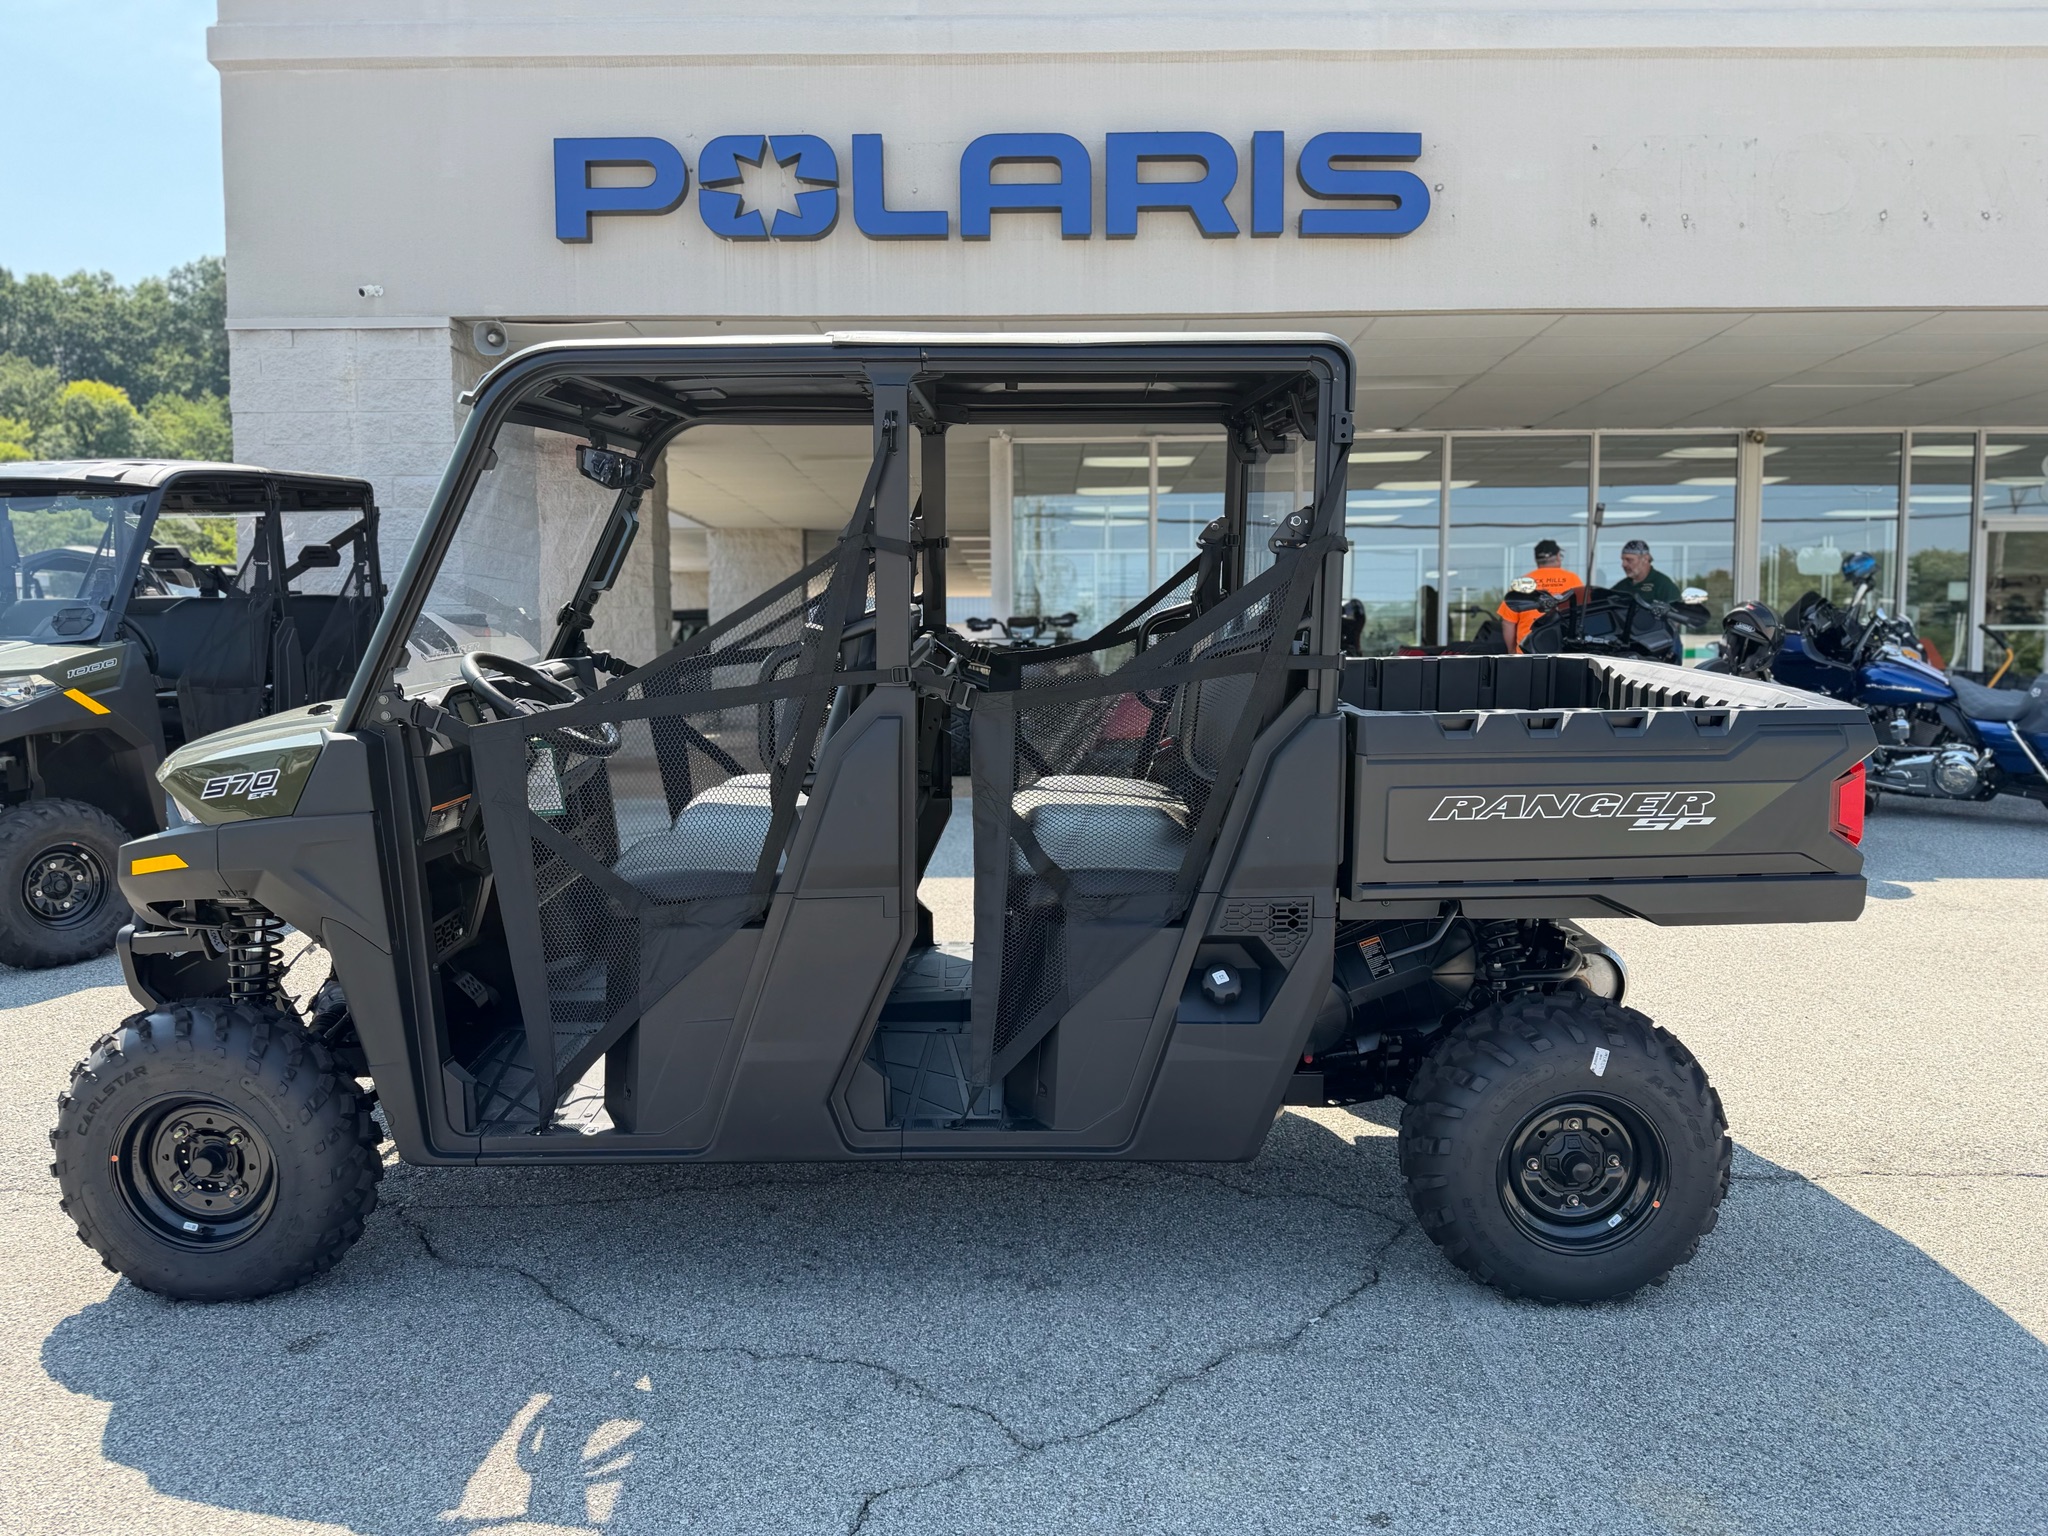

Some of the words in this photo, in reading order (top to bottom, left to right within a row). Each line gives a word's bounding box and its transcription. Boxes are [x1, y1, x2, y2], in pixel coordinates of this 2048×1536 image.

[554, 131, 1432, 243] POLARIS
[67, 658, 117, 679] 1000
[200, 768, 280, 800] 570
[247, 789, 278, 800] EFI
[1428, 791, 1716, 820] RANGER
[1627, 817, 1717, 831] SP
[77, 1065, 148, 1136] CARLSTAR
